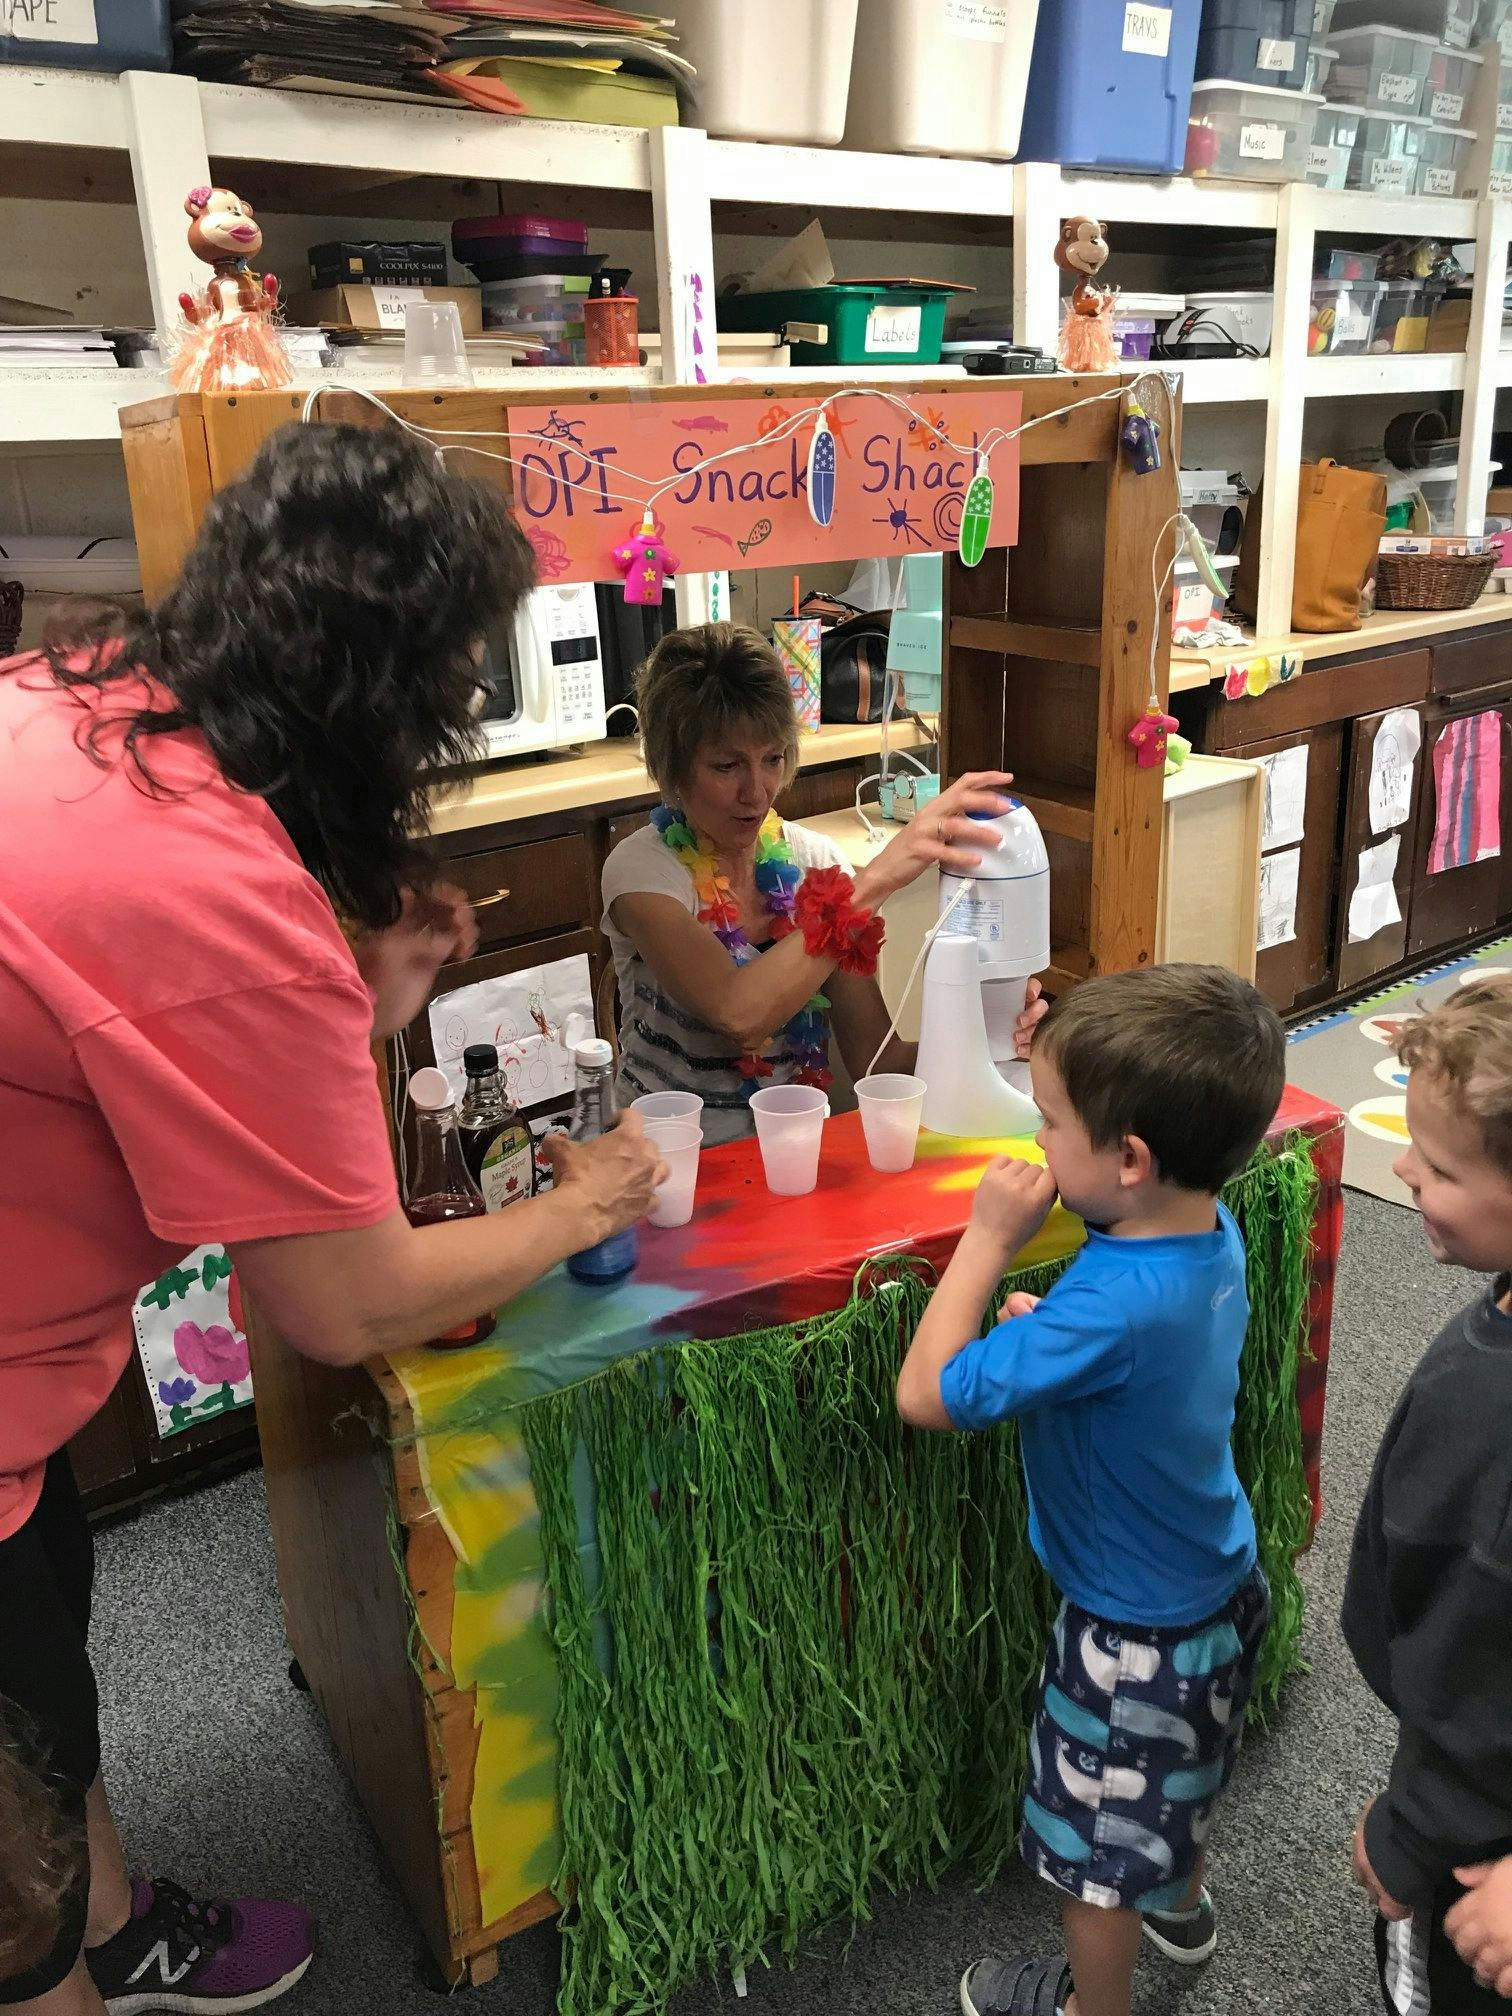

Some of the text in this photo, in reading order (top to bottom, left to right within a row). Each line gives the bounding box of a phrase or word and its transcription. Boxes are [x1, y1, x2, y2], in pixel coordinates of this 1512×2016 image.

[1126, 13, 1158, 39] TRAYS
[1244, 135, 1266, 150] Music
[380, 262, 420, 270] COOLPIX
[382, 303, 407, 315] BLA
[872, 318, 917, 342] Labels
[1338, 317, 1355, 334] Balls
[520, 446, 623, 518] OPI
[672, 436, 808, 504] Snack
[1184, 586, 1201, 600] OPI
[491, 1157, 527, 1182] Maple Syrup
